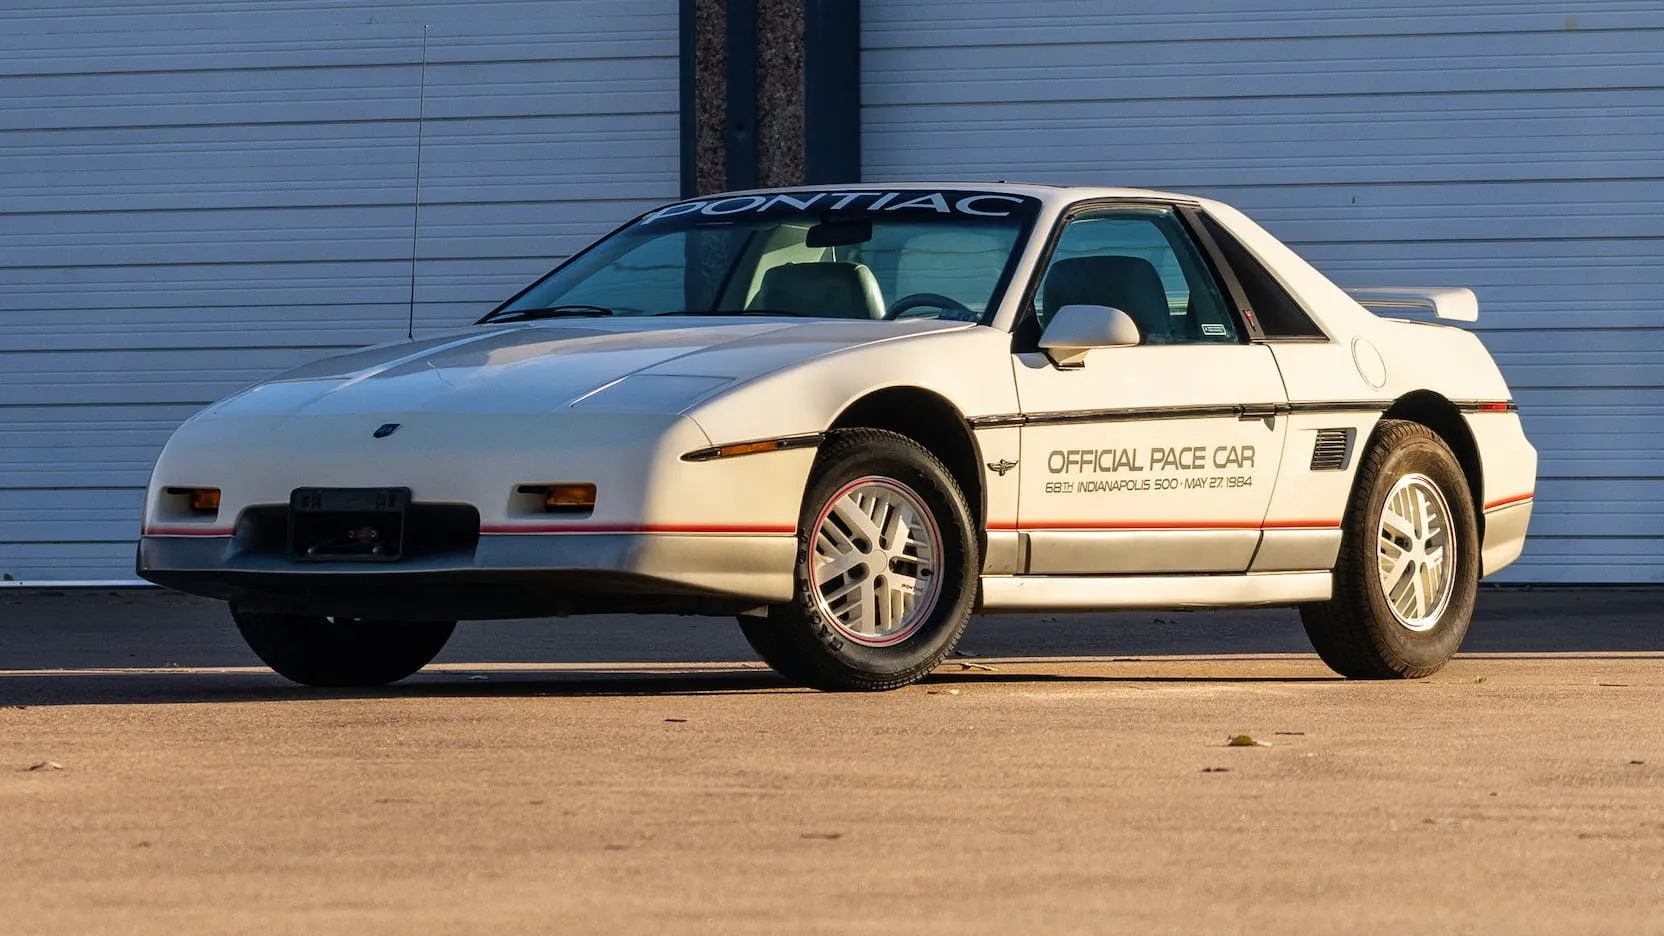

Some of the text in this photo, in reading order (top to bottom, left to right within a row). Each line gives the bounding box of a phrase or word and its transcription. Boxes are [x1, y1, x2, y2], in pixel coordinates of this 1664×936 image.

[640, 192, 1024, 226] PONTIAC
[1047, 445, 1255, 474] OFFICIAL PACE CAR
[1077, 479, 1151, 493] INDIANAPOLIS
[1184, 477, 1208, 490] MAY
[1226, 476, 1253, 488] 1984
